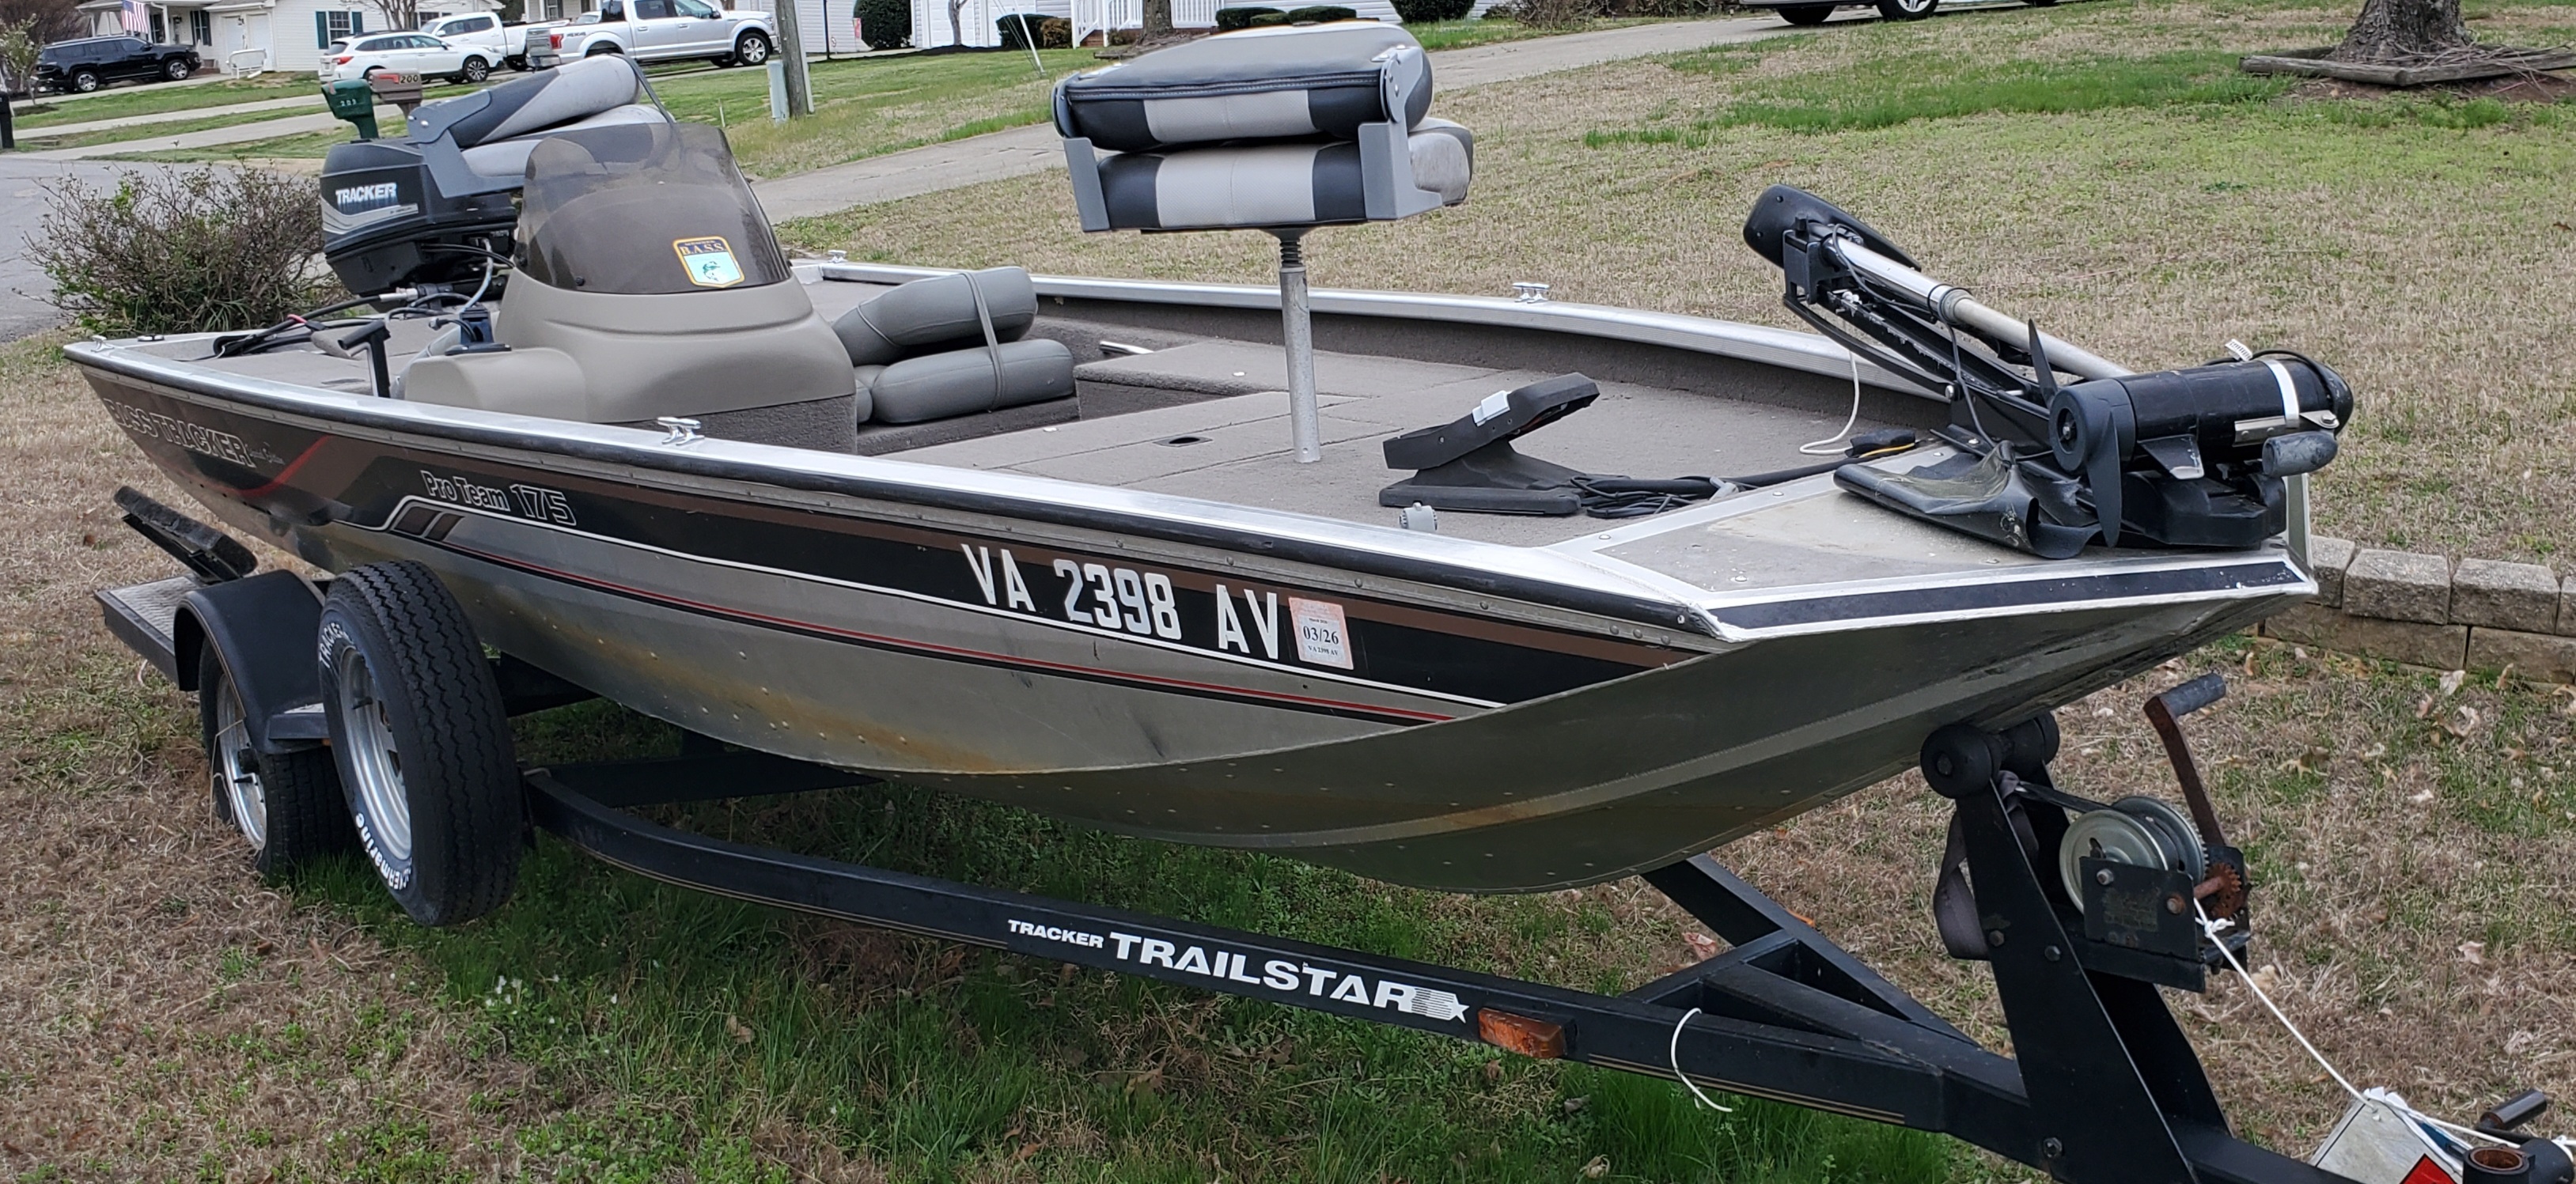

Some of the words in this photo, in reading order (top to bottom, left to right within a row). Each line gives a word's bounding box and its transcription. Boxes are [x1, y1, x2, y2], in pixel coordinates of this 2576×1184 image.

[400, 74, 419, 83] 200
[335, 182, 397, 204] TRACKER
[150, 412, 256, 468] TRACKER
[420, 470, 457, 501] Pro
[453, 476, 511, 512] Team
[510, 484, 577, 526] 175
[960, 543, 1036, 612] VA
[1053, 558, 1182, 641] 2398
[1216, 584, 1279, 660] AV
[1303, 626, 1339, 645] 03/26
[1007, 919, 1104, 948] TRACKER
[1109, 932, 1416, 1014] TRAILSTAR
